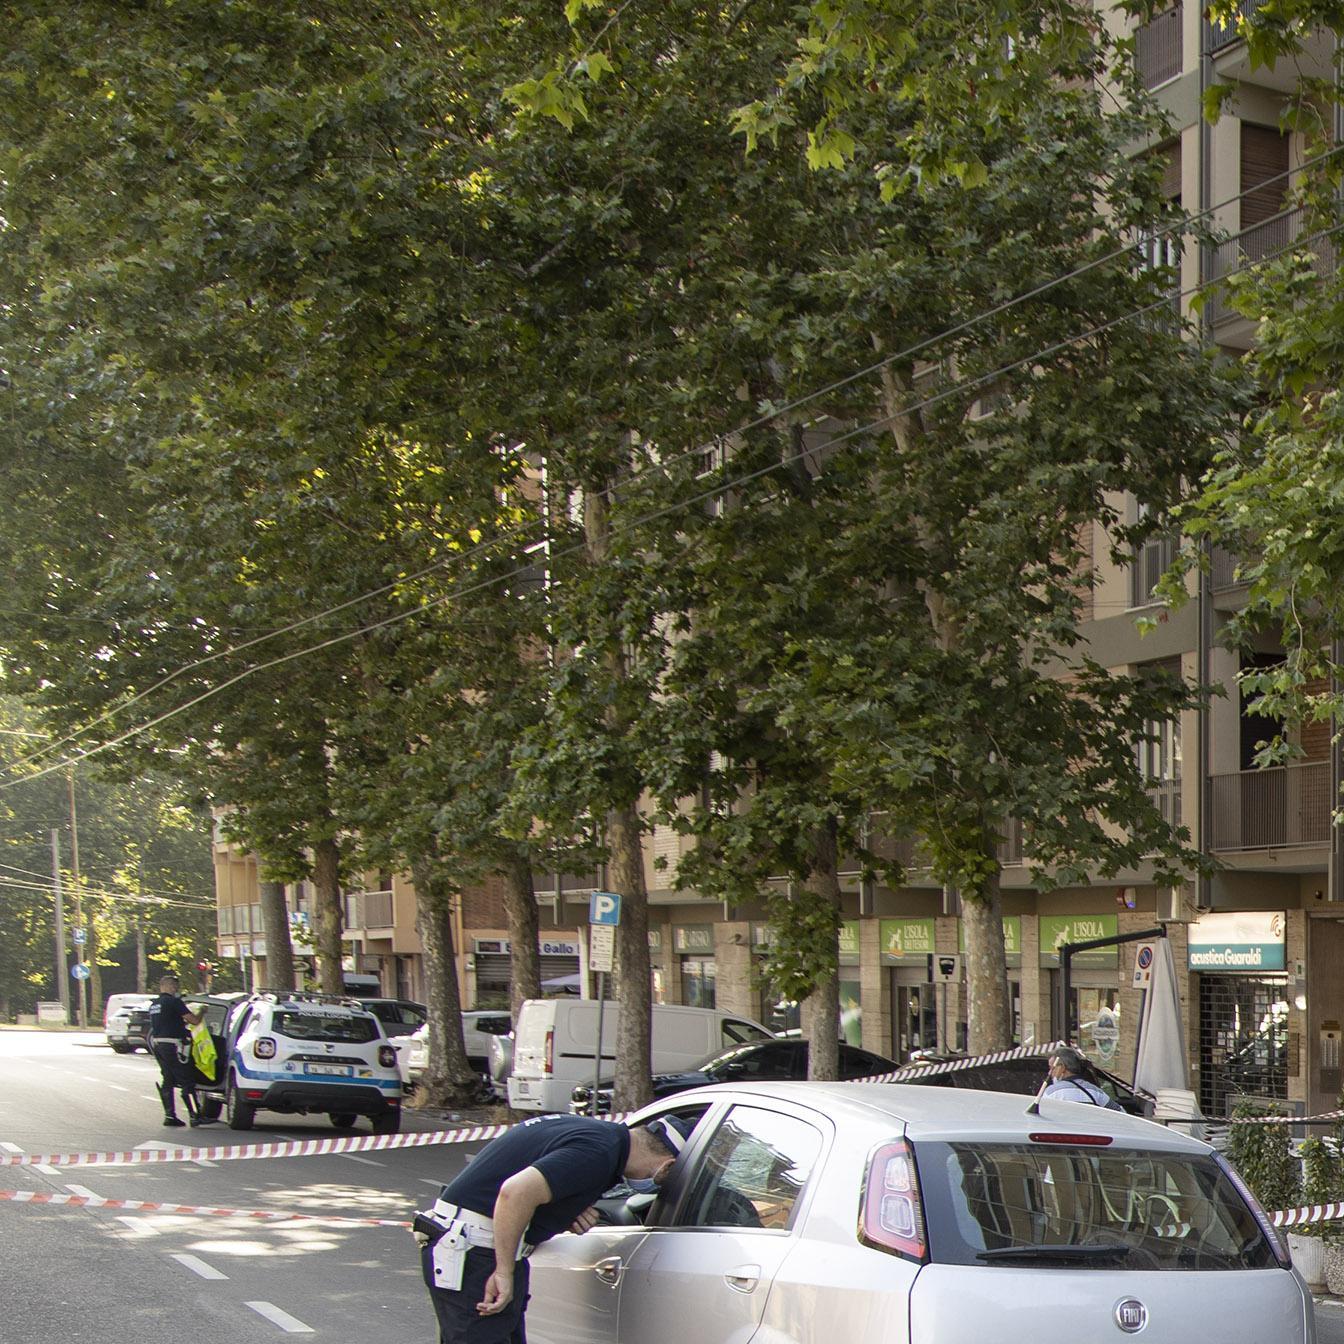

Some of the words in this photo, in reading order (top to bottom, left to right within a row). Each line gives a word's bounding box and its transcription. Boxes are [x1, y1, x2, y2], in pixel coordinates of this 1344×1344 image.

[594, 896, 615, 920] P
[543, 943, 573, 954] Gallo
[1191, 952, 1224, 965] acustica
[1224, 948, 1262, 966] Guaraldi
[1124, 1308, 1140, 1323] FIAT
